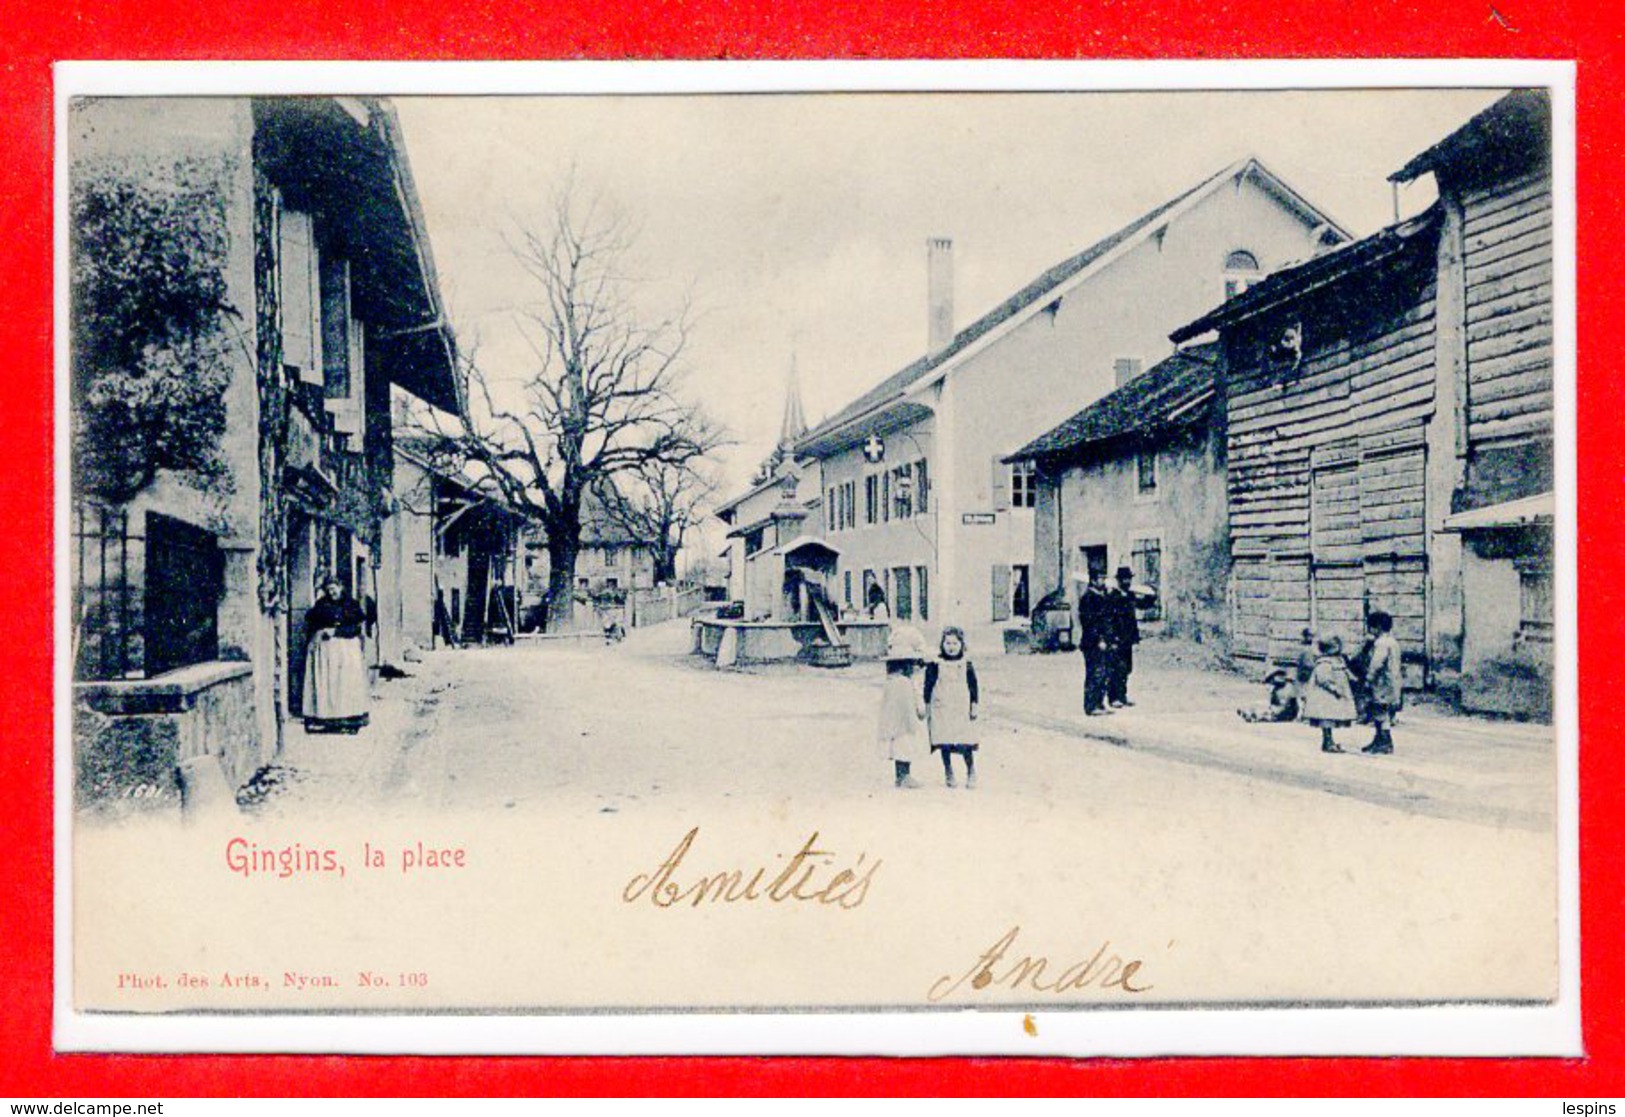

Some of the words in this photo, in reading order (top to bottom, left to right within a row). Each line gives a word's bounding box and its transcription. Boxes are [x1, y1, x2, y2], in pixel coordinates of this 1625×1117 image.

[226, 837, 347, 877] Gingins,
[364, 842, 386, 868] la
[402, 842, 466, 872] place
[622, 826, 883, 909] Amitiés
[118, 973, 168, 989] Phot.
[177, 972, 209, 988] des
[219, 972, 270, 992] Arts,
[283, 972, 339, 992] Nyon.
[358, 972, 389, 988] No.
[399, 972, 428, 988] 103
[927, 925, 1177, 1002] André
